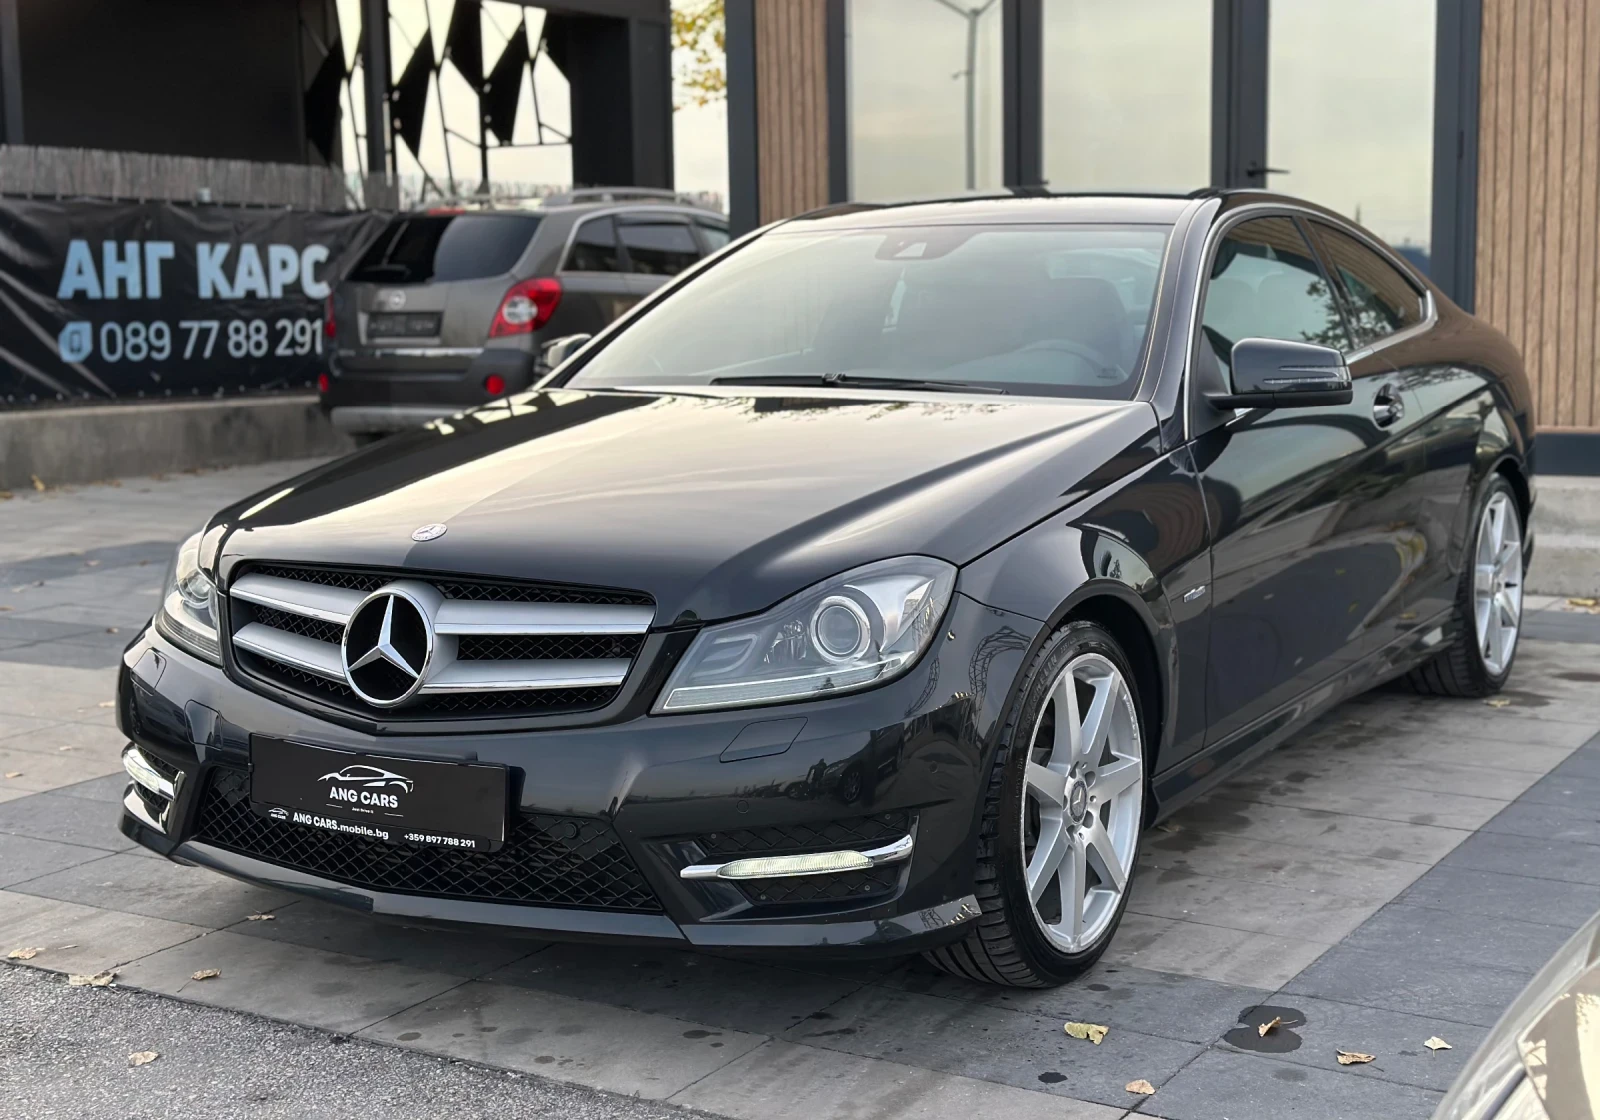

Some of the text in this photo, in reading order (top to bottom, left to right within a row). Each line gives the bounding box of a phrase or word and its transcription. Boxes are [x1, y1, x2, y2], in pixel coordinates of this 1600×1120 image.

[57, 239, 332, 300] АНГ КАРС
[100, 318, 323, 362] 089 77 88 291
[329, 786, 398, 809] ANG CARS
[292, 812, 389, 840] ANG CARS.mobile.bg
[404, 832, 476, 848] +359 897 788 291
